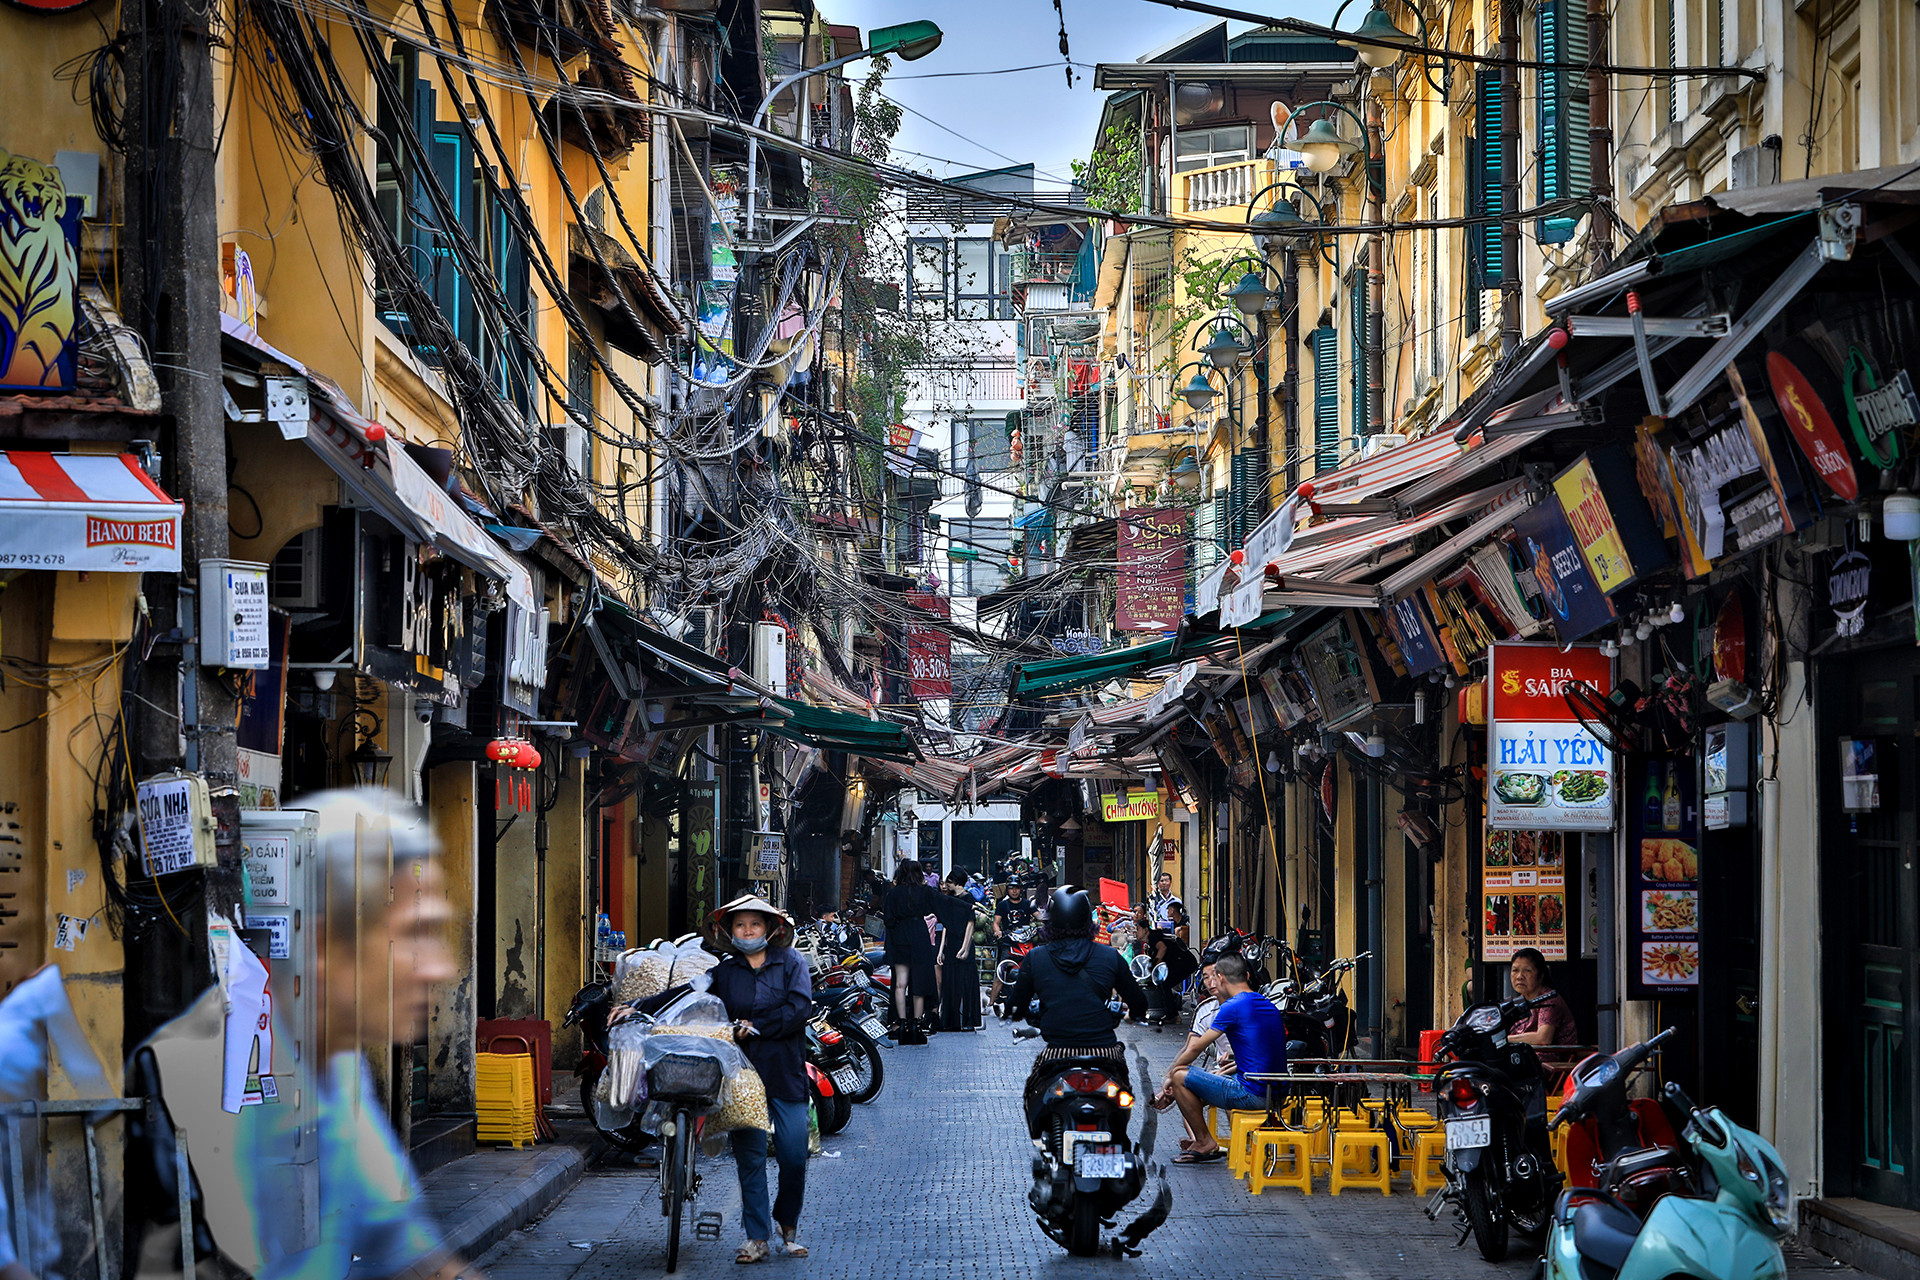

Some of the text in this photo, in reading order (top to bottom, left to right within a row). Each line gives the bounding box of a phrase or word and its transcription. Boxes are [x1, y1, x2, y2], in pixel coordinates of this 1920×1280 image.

[1814, 450, 1849, 476] SAIGON
[90, 519, 173, 546] HANOI BEER
[1142, 516, 1181, 549] Spa
[20, 555, 40, 565] 932
[44, 555, 65, 565] 678
[1551, 548, 1575, 580] BEER
[1550, 668, 1574, 678] BIA
[1500, 728, 1605, 765] HẢI YẾN
